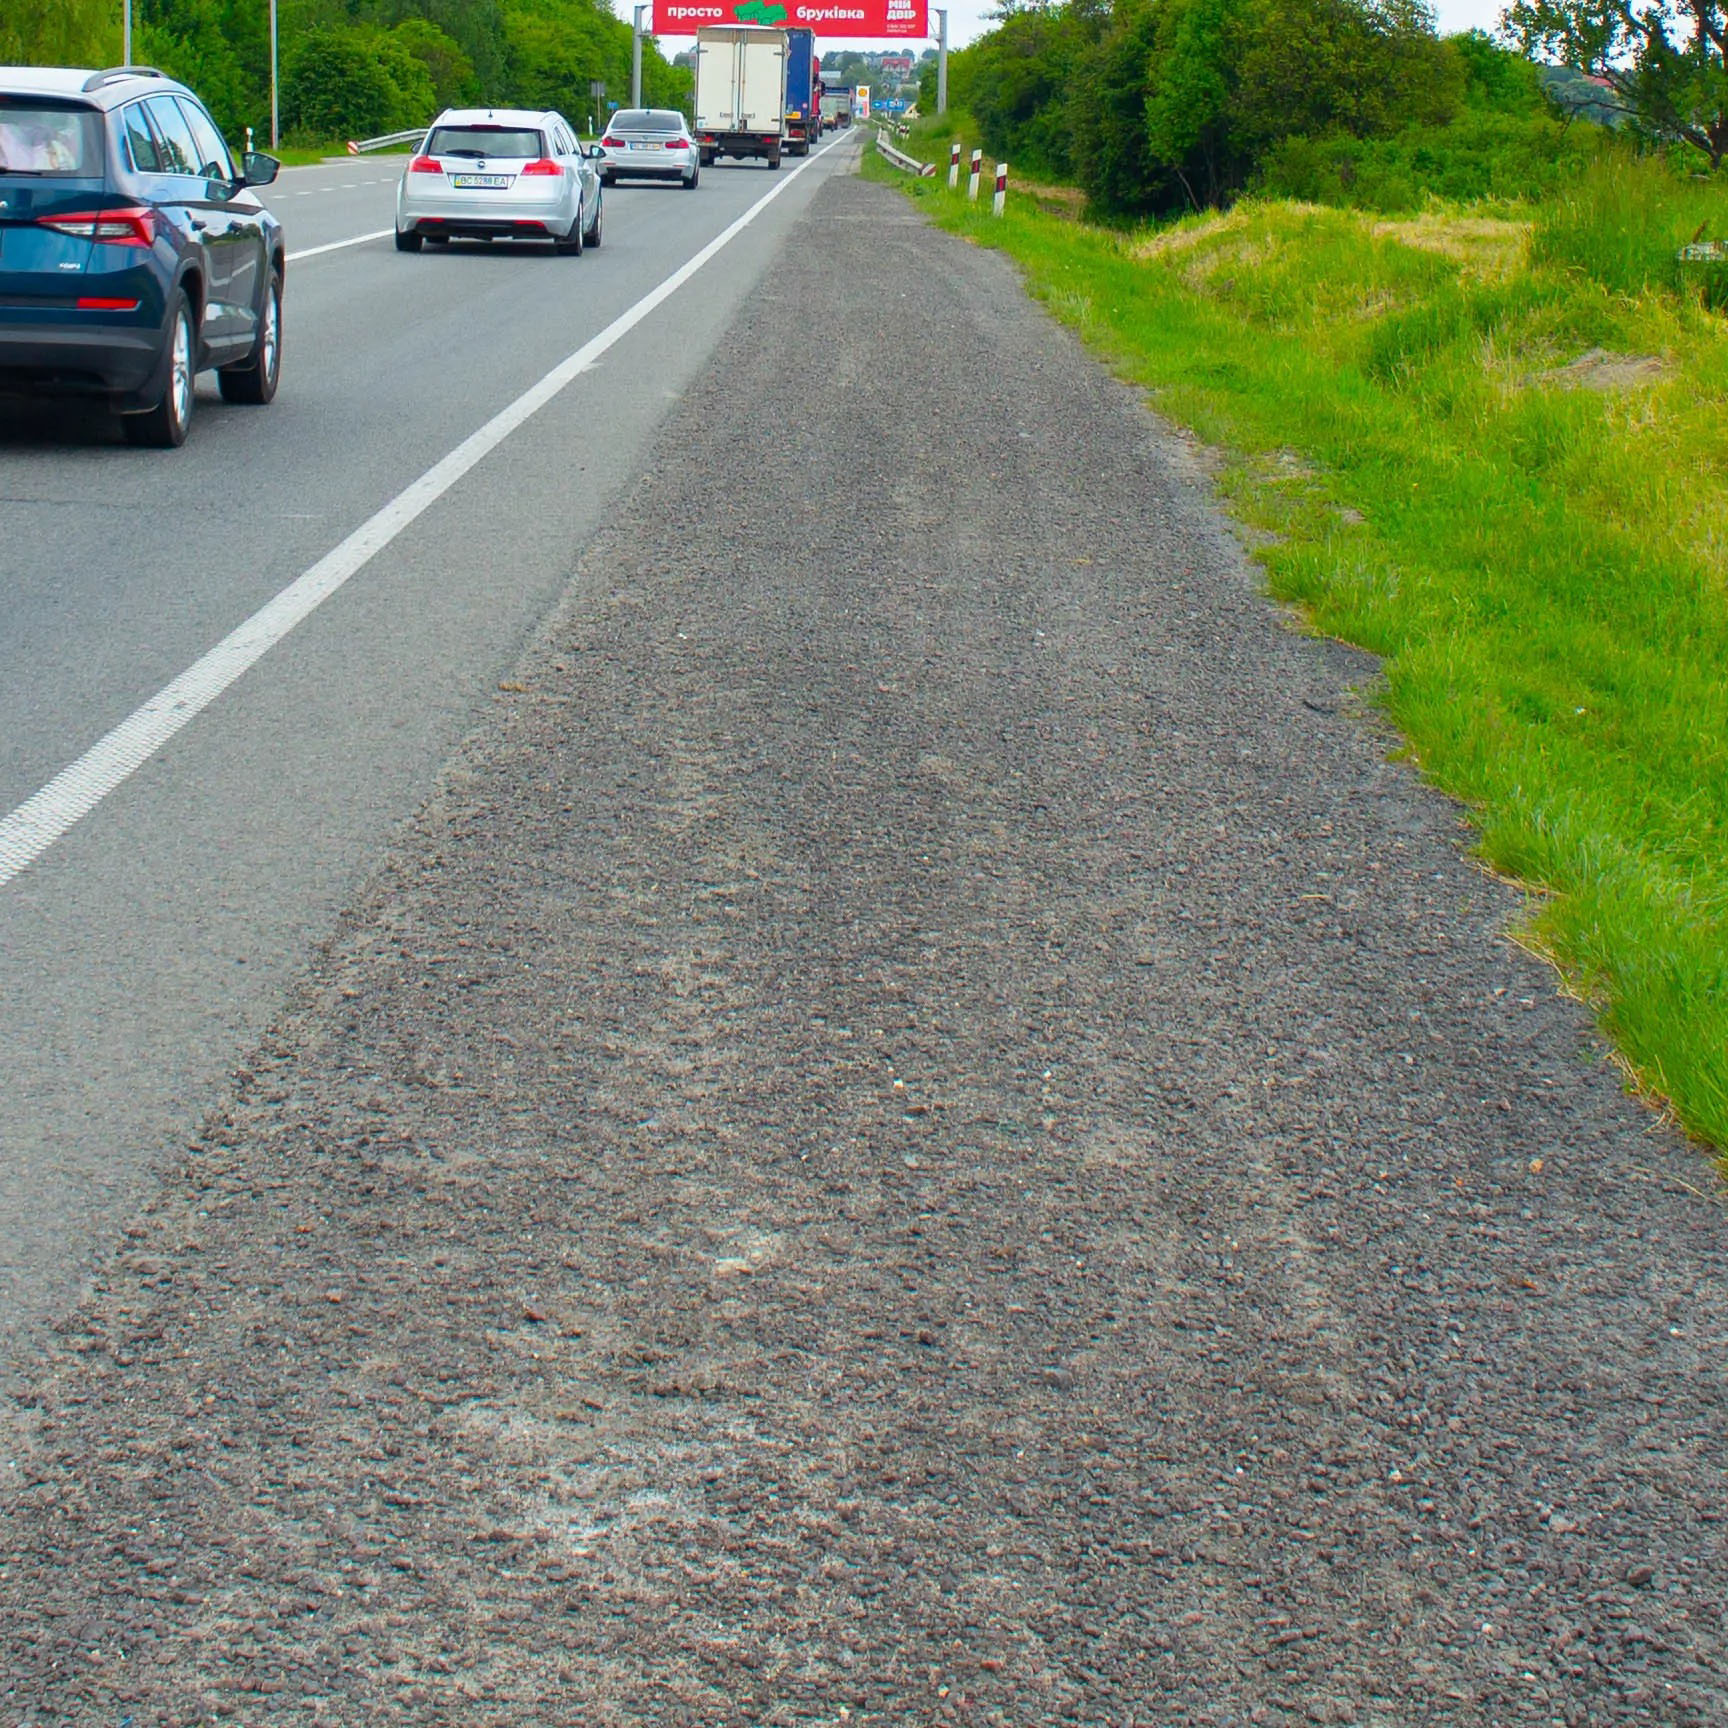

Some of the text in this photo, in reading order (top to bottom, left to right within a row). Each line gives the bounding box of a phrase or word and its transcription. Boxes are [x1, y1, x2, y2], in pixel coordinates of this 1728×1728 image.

[667, 5, 865, 21] просто бруківка
[886, 10, 917, 20] ДВІР
